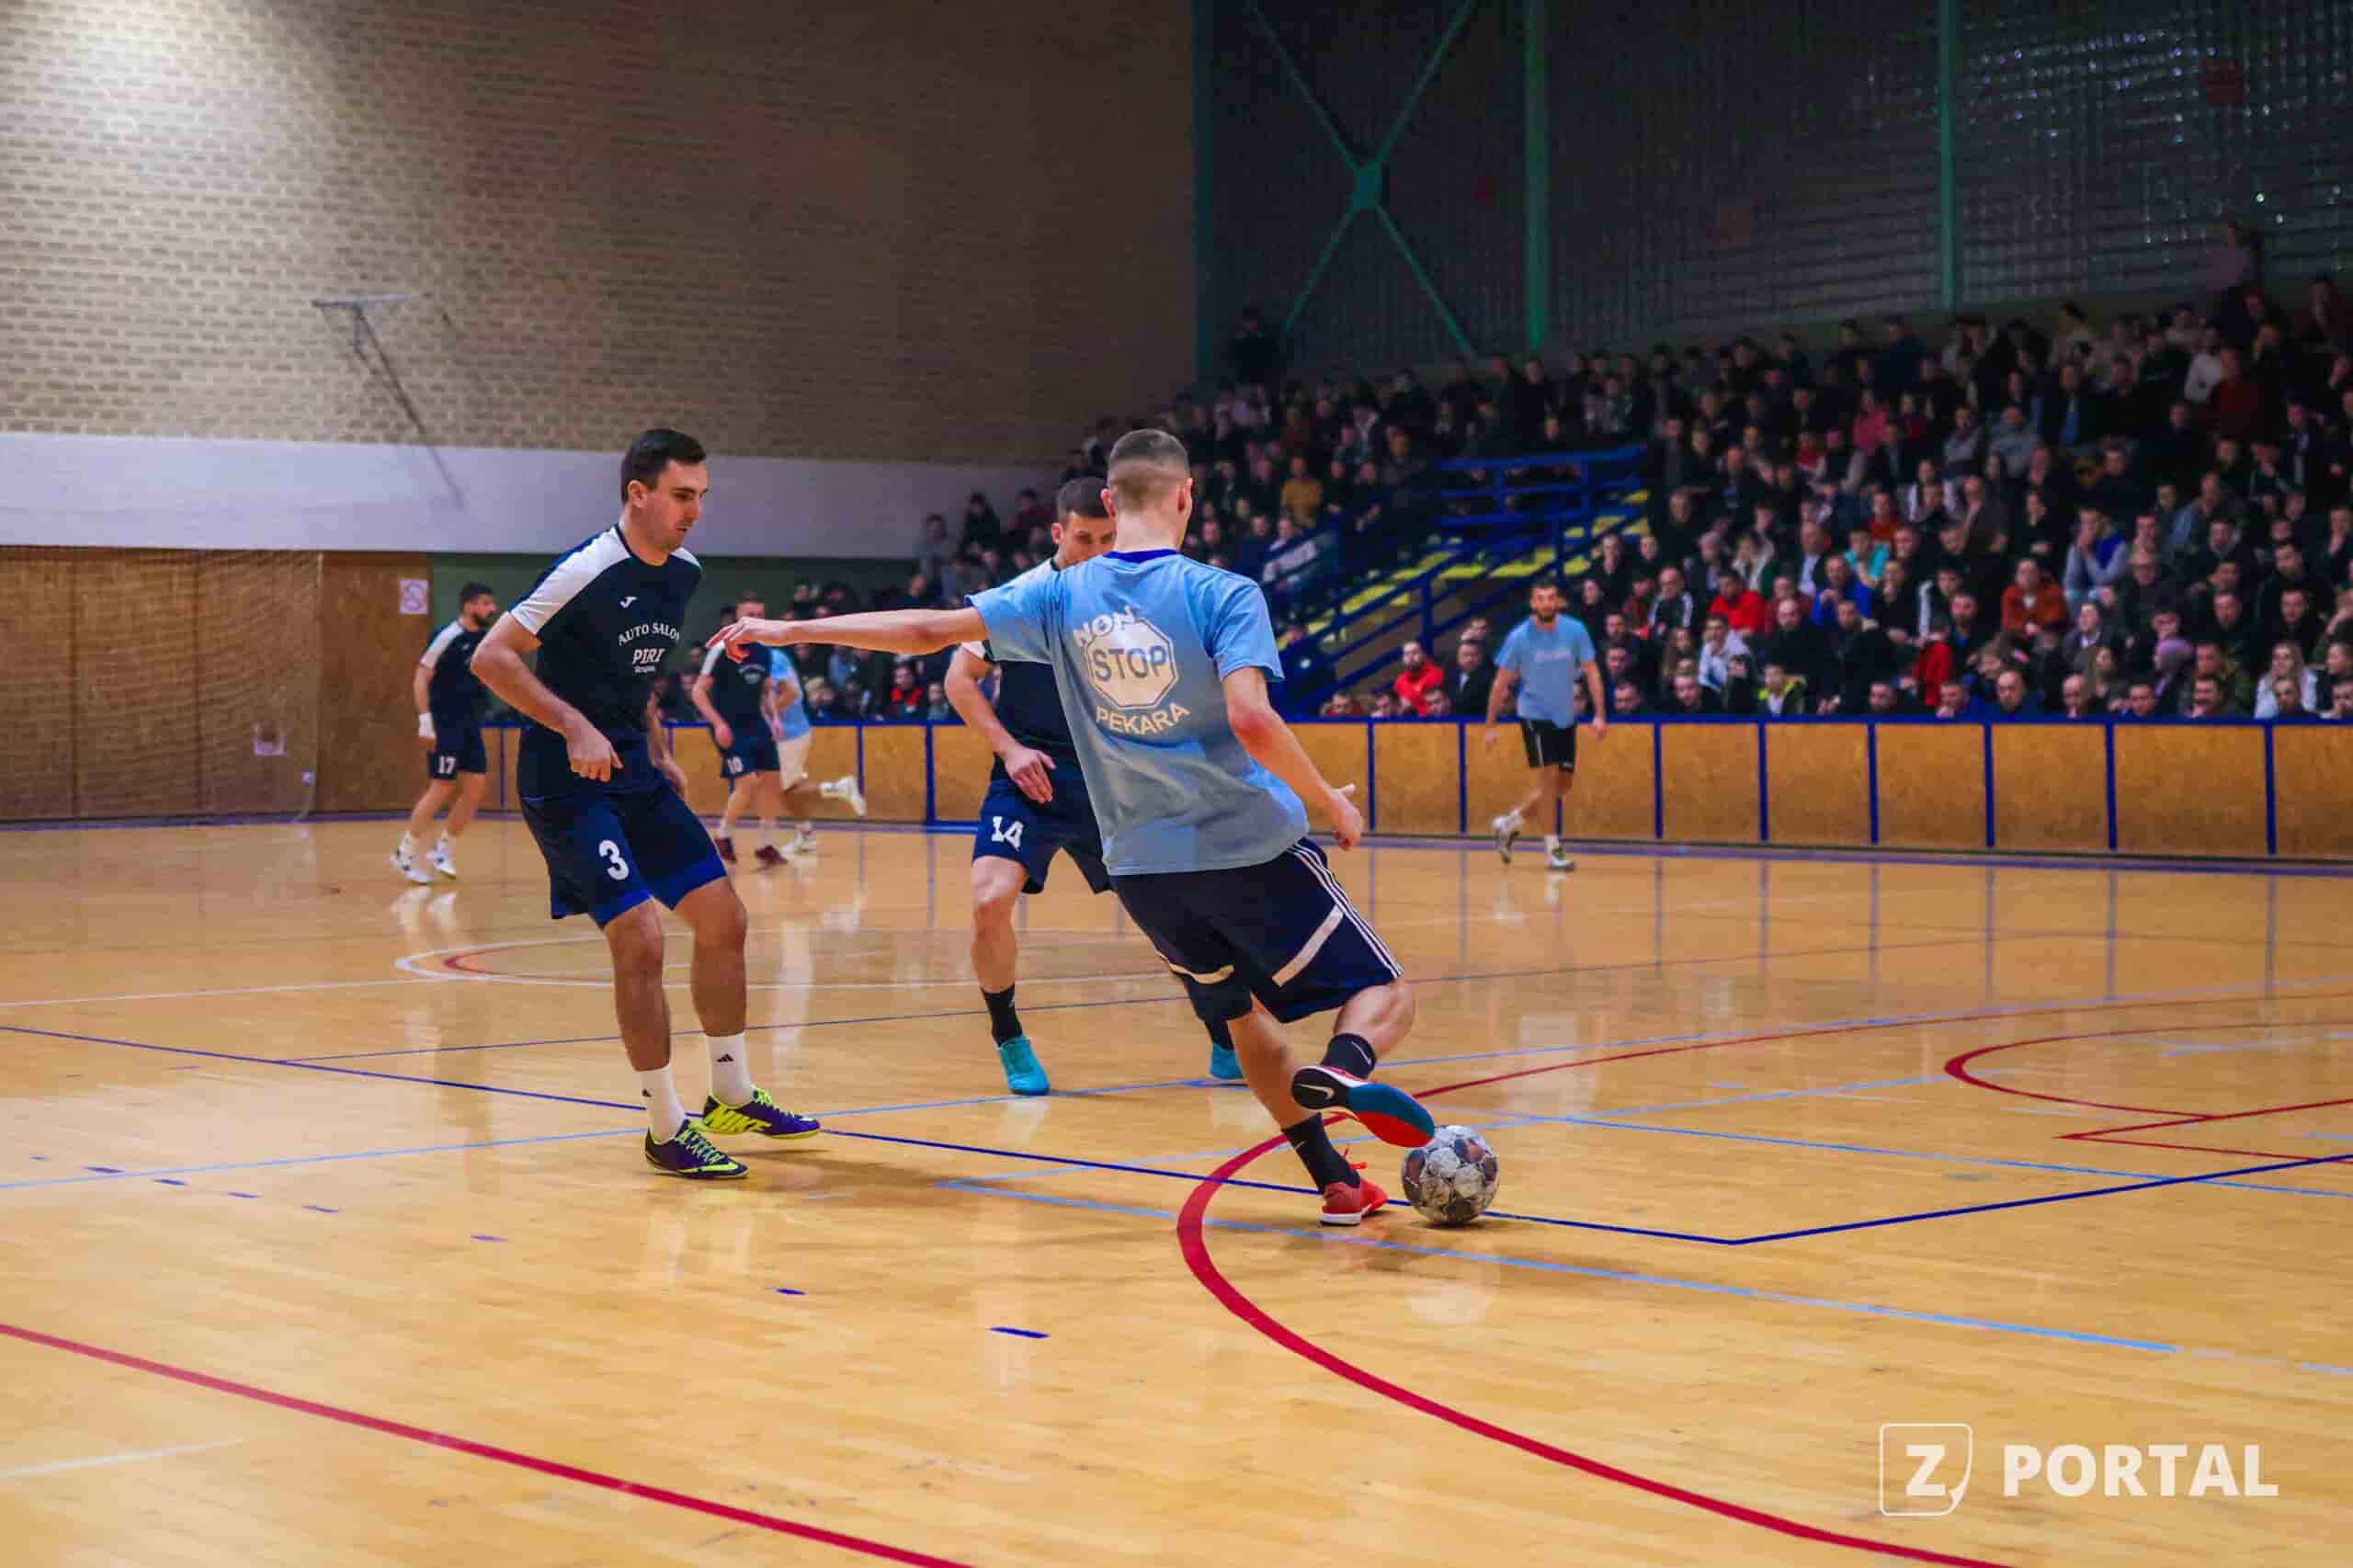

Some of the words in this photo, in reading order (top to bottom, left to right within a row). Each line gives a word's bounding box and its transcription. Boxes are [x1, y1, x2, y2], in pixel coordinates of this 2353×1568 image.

[618, 623, 649, 646] AUTO
[1074, 605, 1135, 647] NON
[632, 648, 665, 664] PIRI
[1092, 645, 1166, 681] STOP
[1096, 702, 1191, 734] PEKARA
[438, 756, 456, 775] 17
[992, 815, 1024, 852] 14
[598, 839, 629, 881] 3
